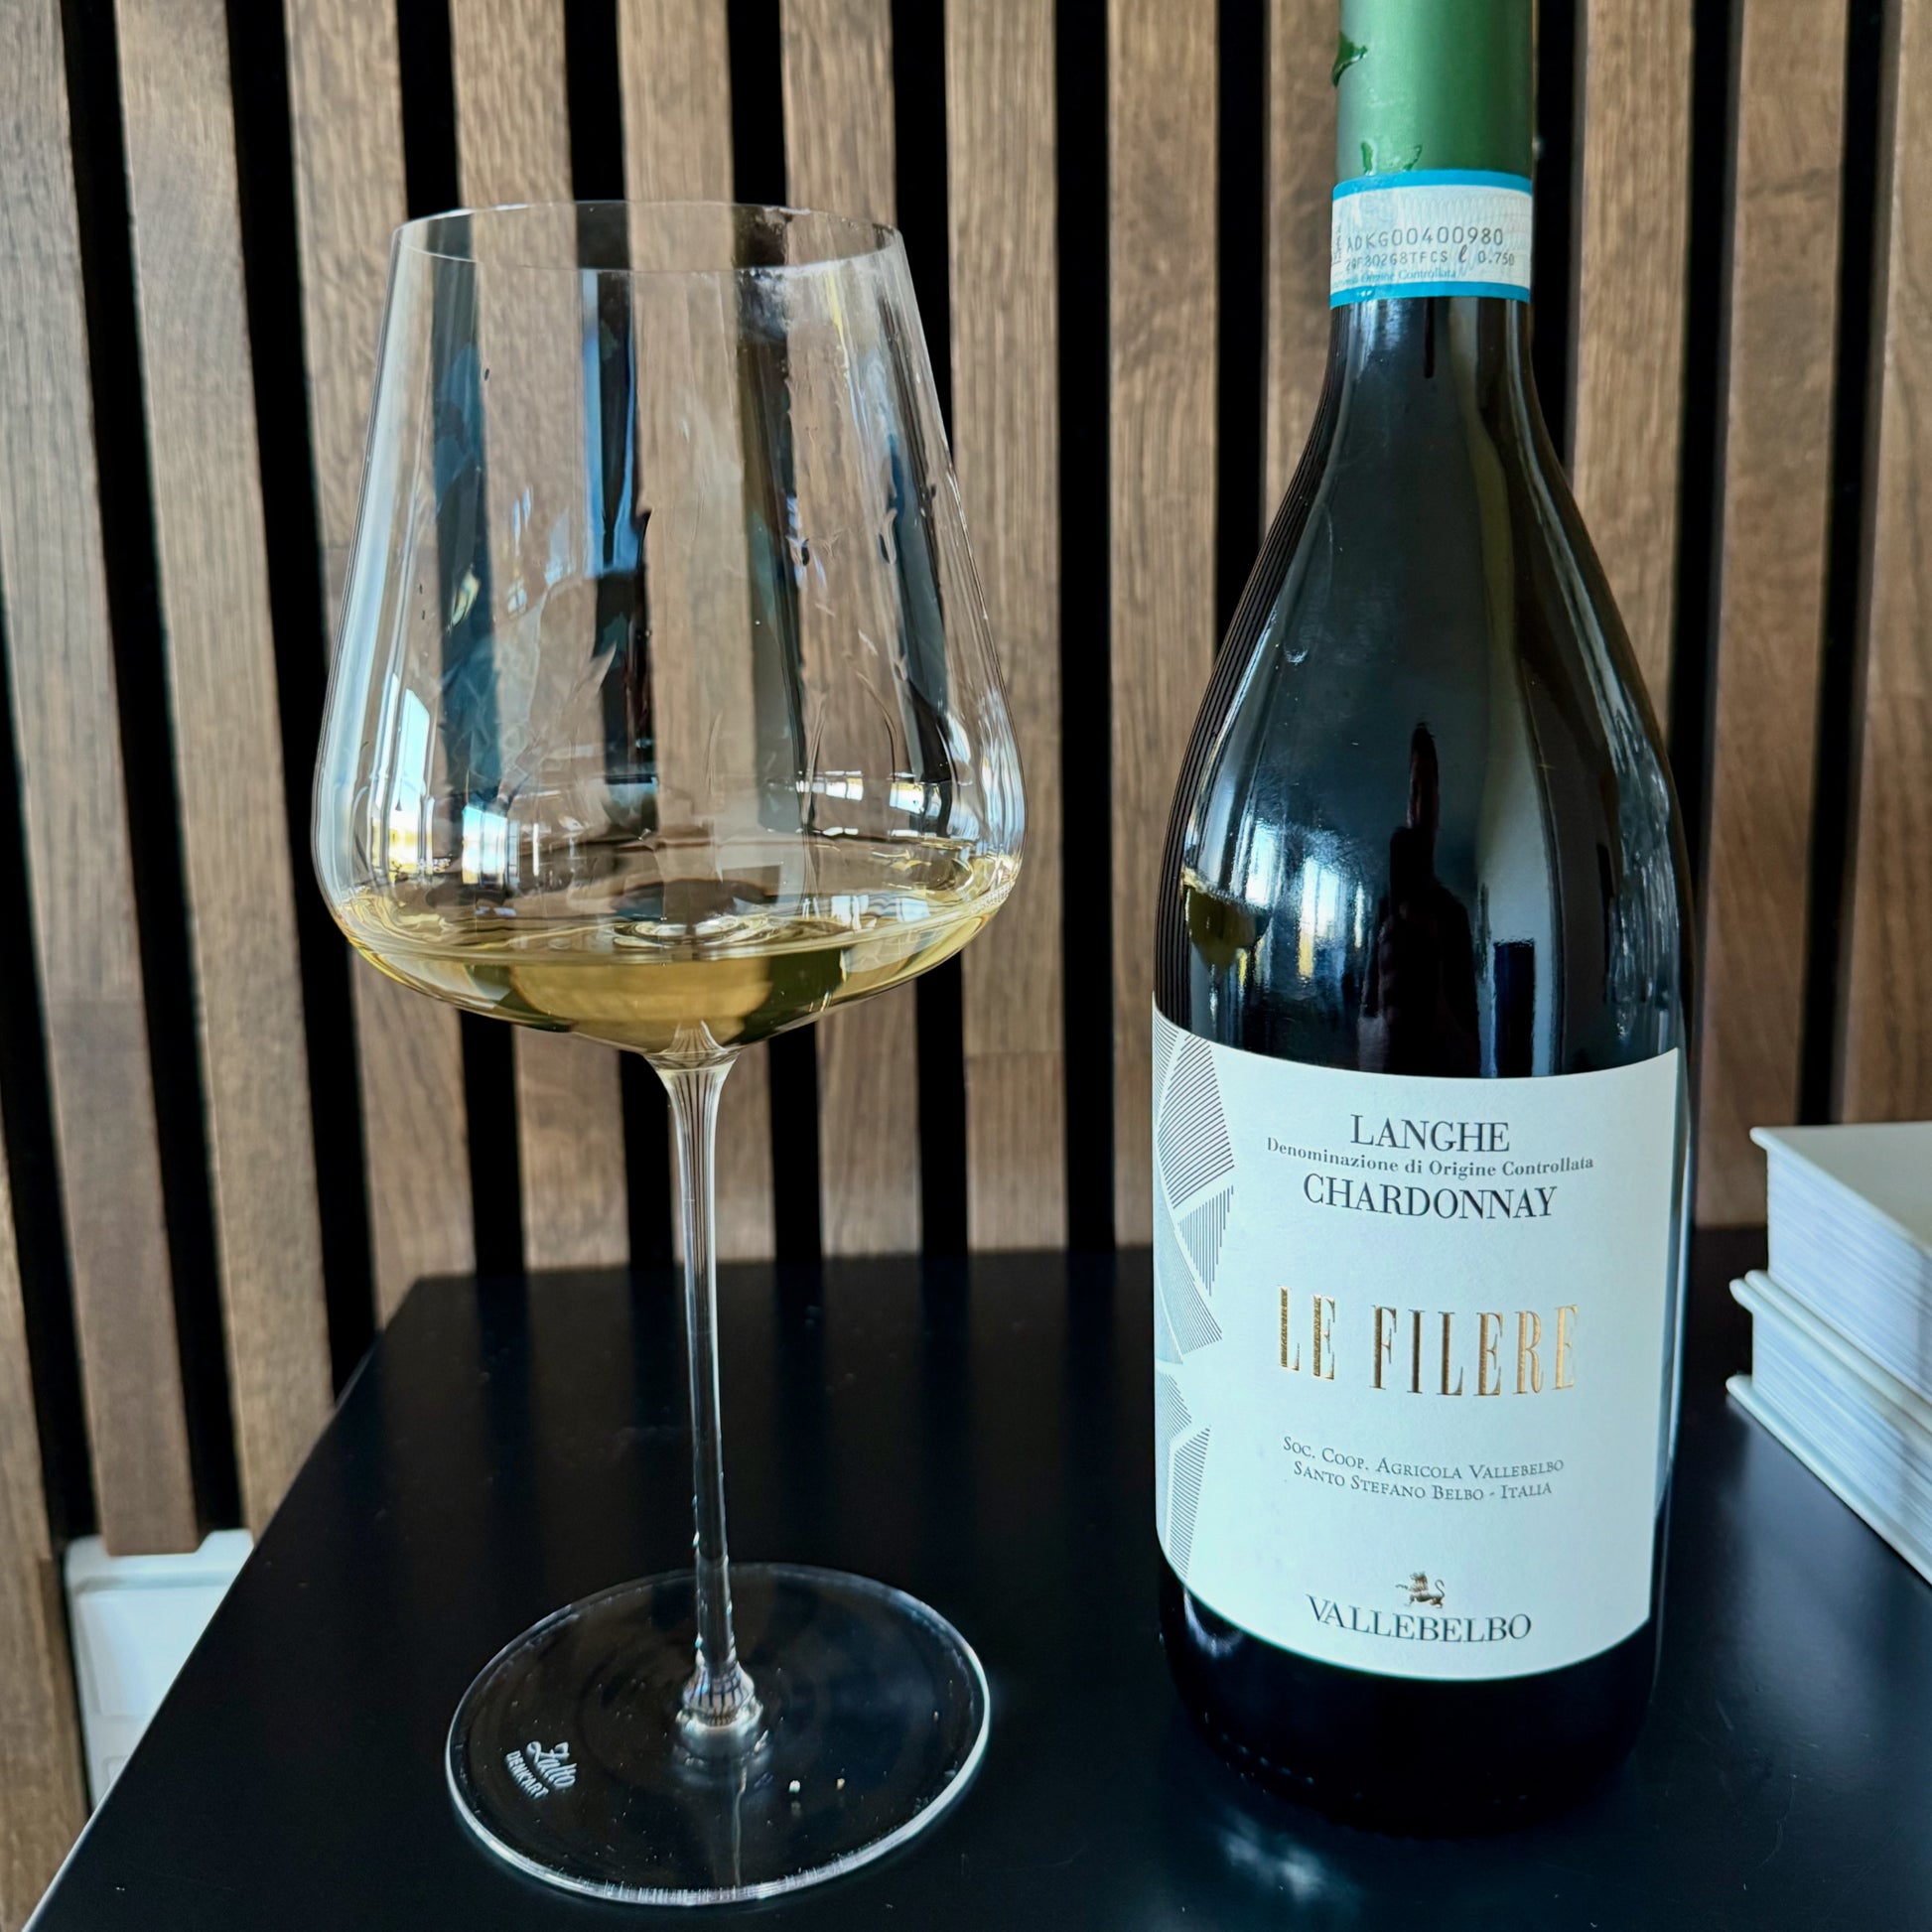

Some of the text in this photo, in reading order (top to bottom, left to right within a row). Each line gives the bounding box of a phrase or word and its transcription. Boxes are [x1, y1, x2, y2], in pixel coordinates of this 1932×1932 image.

[1478, 250, 1515, 266] 0.750
[1349, 1114, 1510, 1152] LANGHE
[1267, 1137, 1593, 1180] Denominazione di Origine Controllata
[1303, 1173, 1558, 1219] CHARDONNAY
[1277, 1284, 1579, 1397] LE FILERE
[1306, 1593, 1532, 1642] VALLEBELBO
